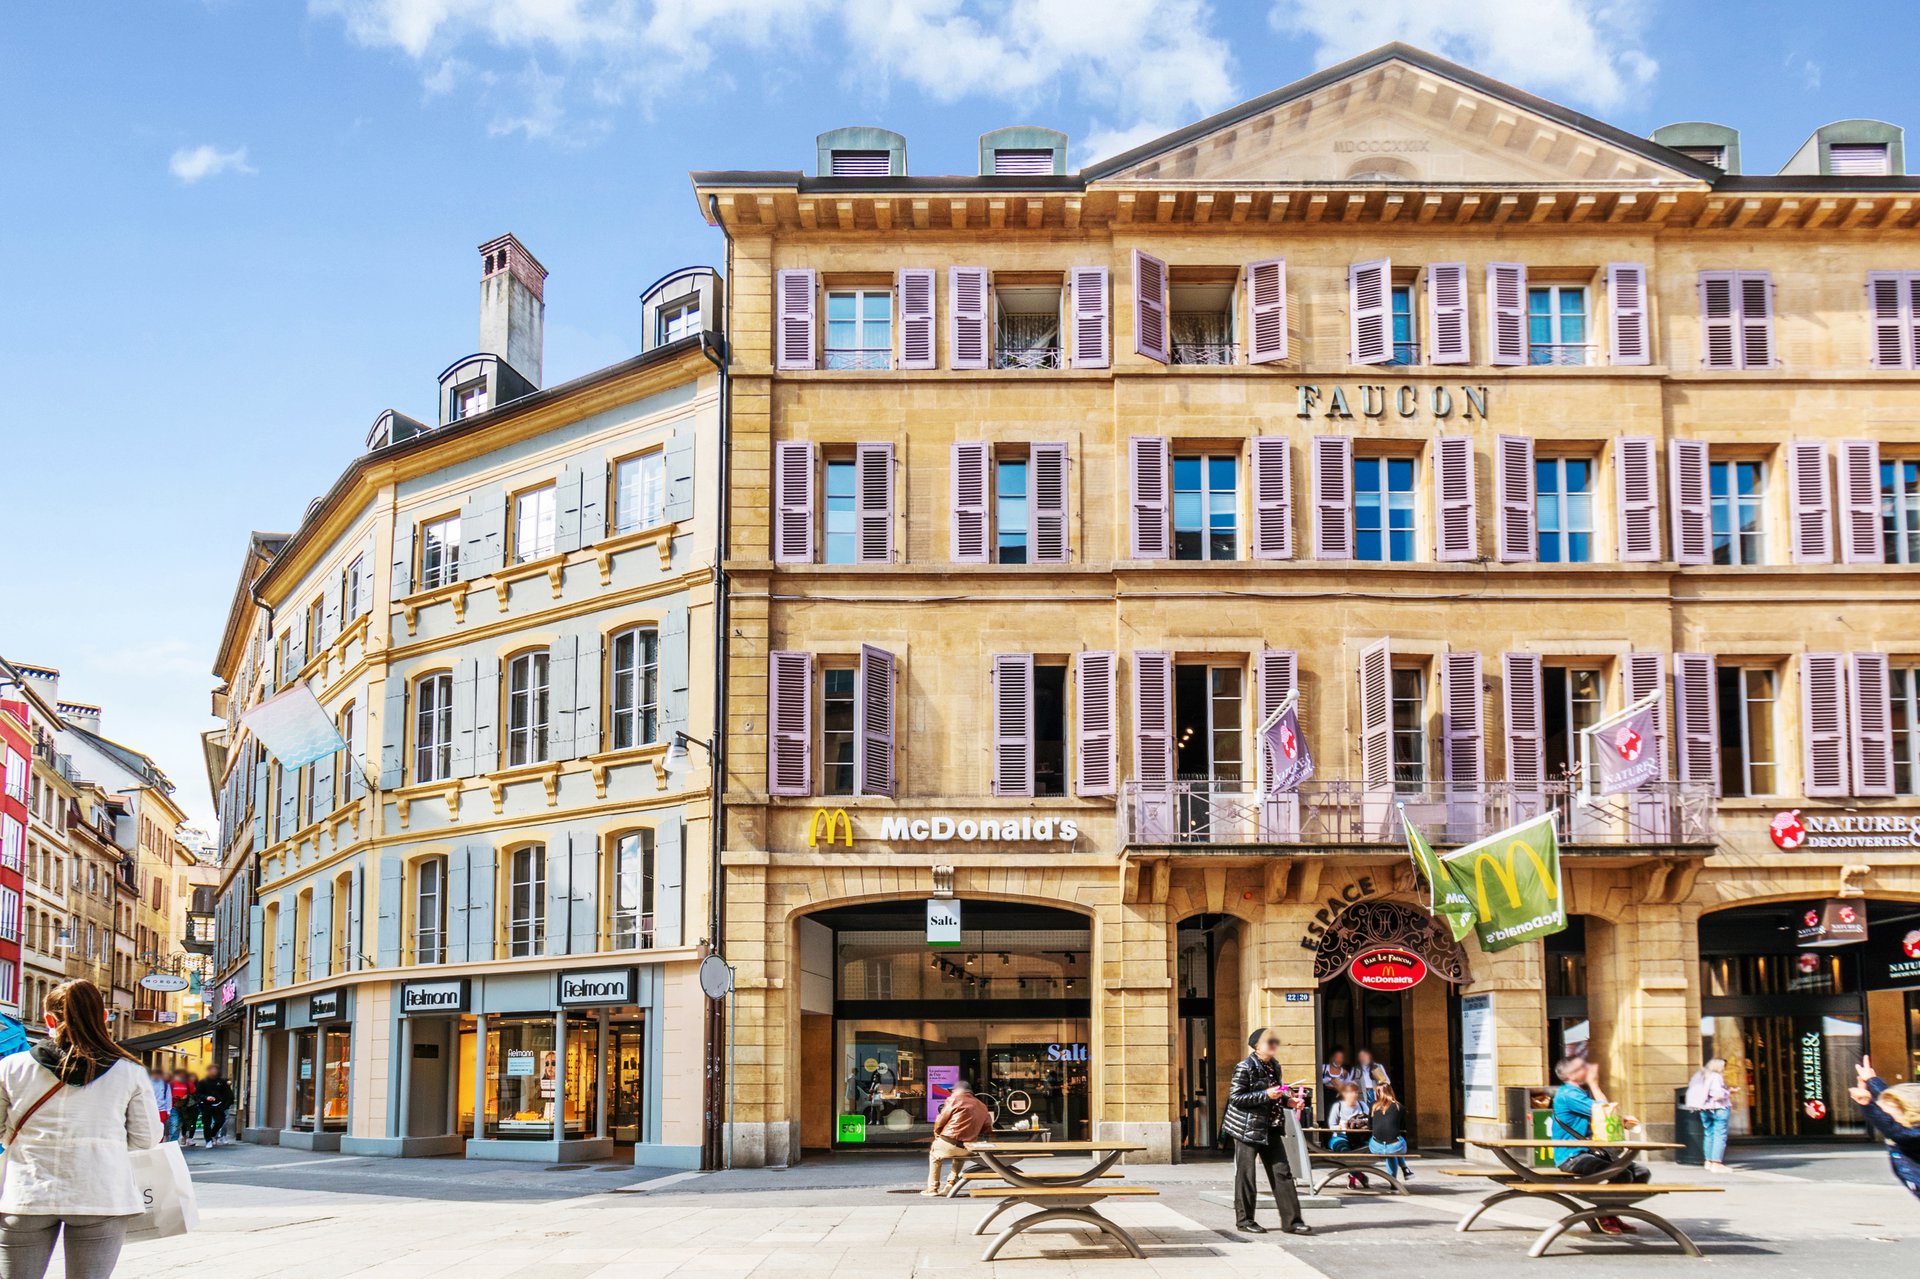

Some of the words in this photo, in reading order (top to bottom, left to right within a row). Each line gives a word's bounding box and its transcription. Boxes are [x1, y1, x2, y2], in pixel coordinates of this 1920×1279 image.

[1295, 385, 1488, 418] FAUCON
[880, 816, 1079, 841] McDonald's
[930, 915, 957, 926] Salt.
[1300, 876, 1375, 951] ESPACE
[1362, 976, 1413, 984] McDonald's
[1287, 993, 1296, 1001] 22
[1299, 993, 1308, 1001] 20
[1047, 1043, 1093, 1061] Salt.
[842, 1124, 856, 1134] 5G
